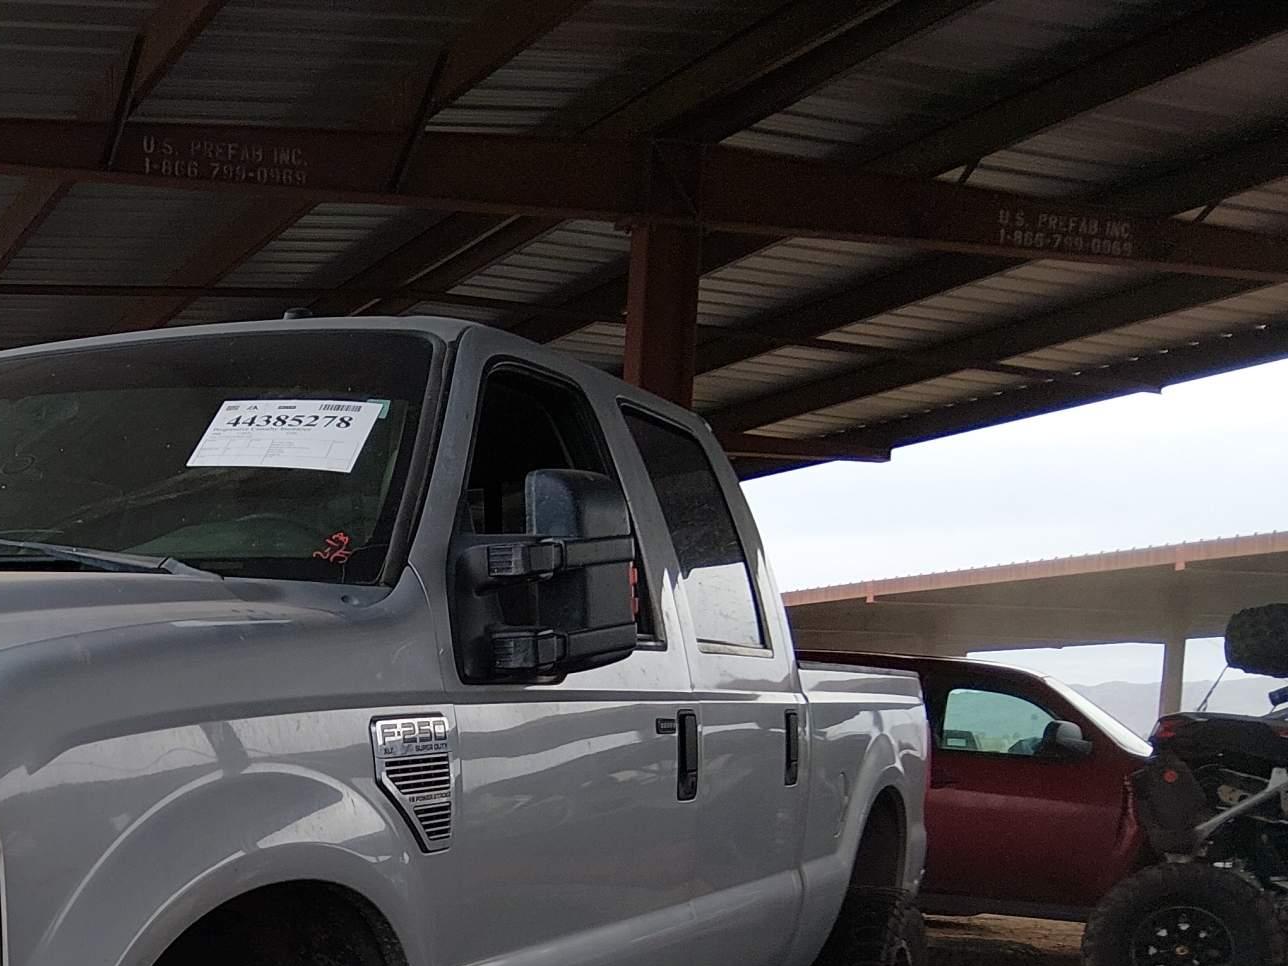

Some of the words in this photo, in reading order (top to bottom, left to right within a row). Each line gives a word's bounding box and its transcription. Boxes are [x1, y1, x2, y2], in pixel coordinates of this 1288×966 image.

[190, 140, 264, 163] PREFAB
[272, 147, 309, 168] INC.
[225, 413, 354, 429] 44385278
[378, 719, 448, 745] F-250
